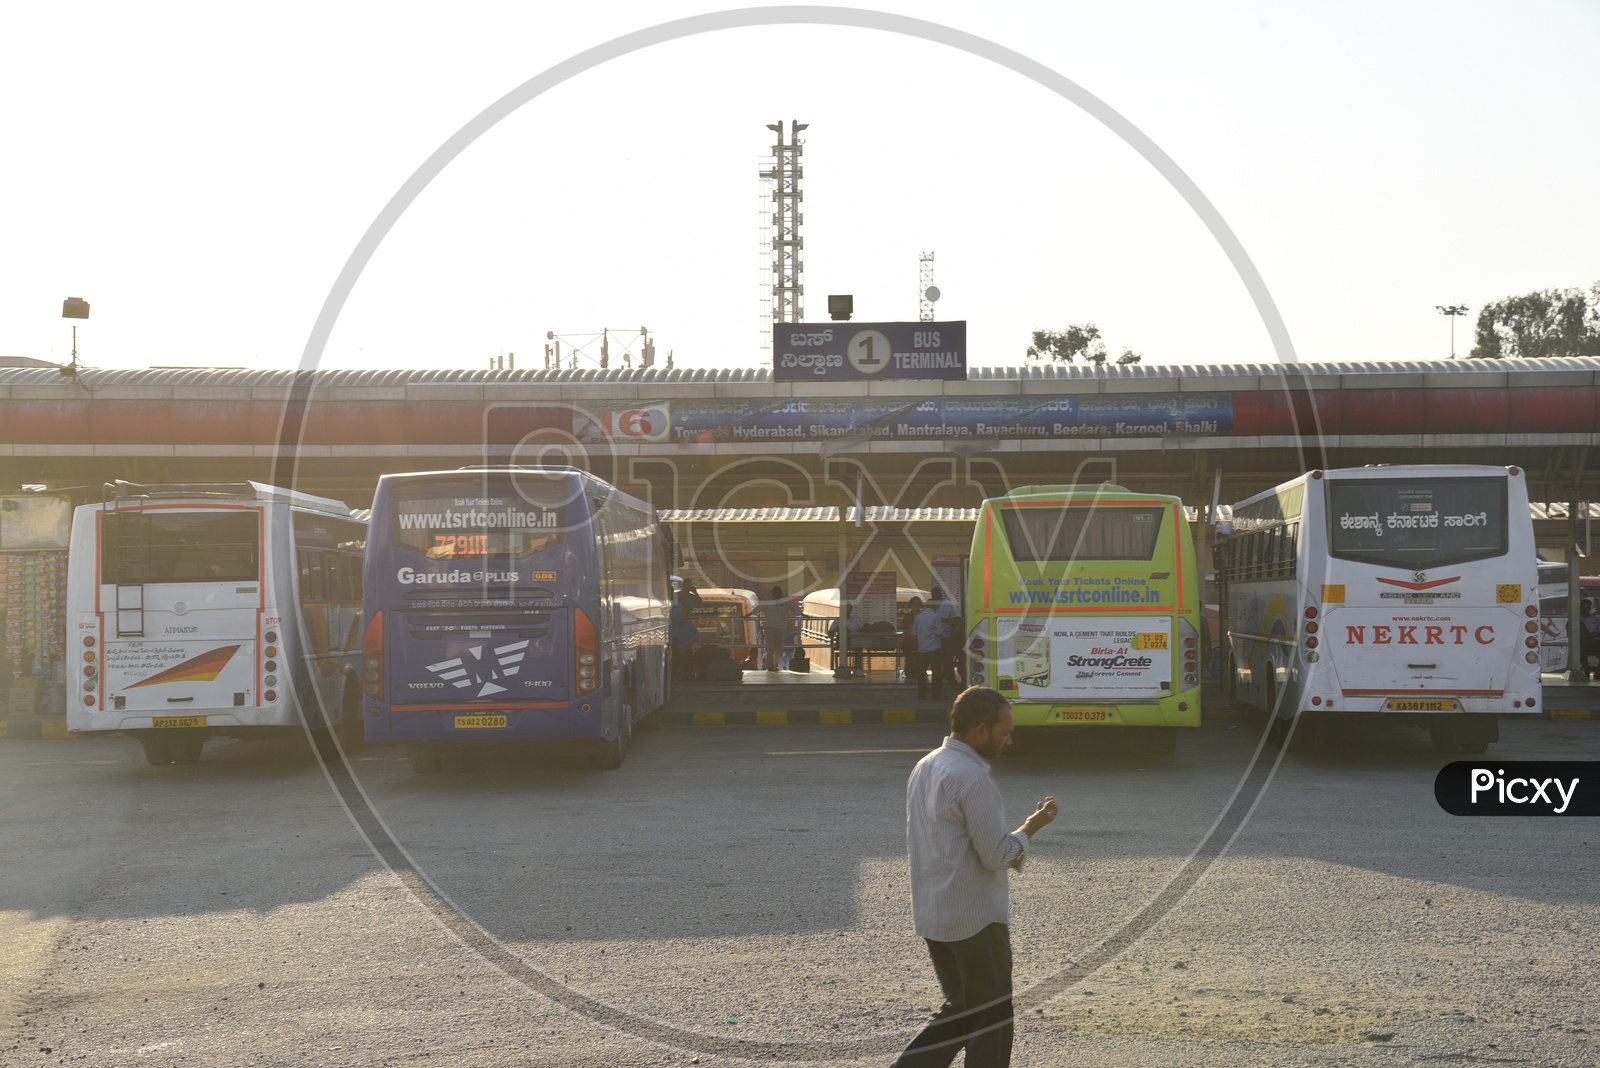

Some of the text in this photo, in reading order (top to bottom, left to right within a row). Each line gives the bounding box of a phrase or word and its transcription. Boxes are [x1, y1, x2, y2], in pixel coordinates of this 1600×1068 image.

[790, 329, 833, 346] ಬಸ್
[914, 331, 941, 348] BUS
[858, 336, 881, 365] 1
[781, 352, 843, 375] ನಿಲ್ದಾಣ
[893, 352, 962, 368] TERMINAL
[733, 425, 806, 439] Hyderabad,
[897, 423, 972, 438] Mantralaya,
[398, 507, 558, 529] www.tsrtconline.in
[1387, 510, 1439, 529] ಕರ್ನಾಟಕ
[1444, 511, 1487, 527] ಸಾರಿಗೆ
[397, 566, 519, 584] Garuda PLUS
[1019, 577, 1147, 586] Book Your Tickets Online
[1009, 586, 1160, 604] www.tsrtconline.in
[164, 626, 198, 634] ATMAKUR
[1346, 625, 1495, 645] NEKRTC
[1067, 655, 1152, 669] StrongCrete
[524, 680, 553, 688] 9400
